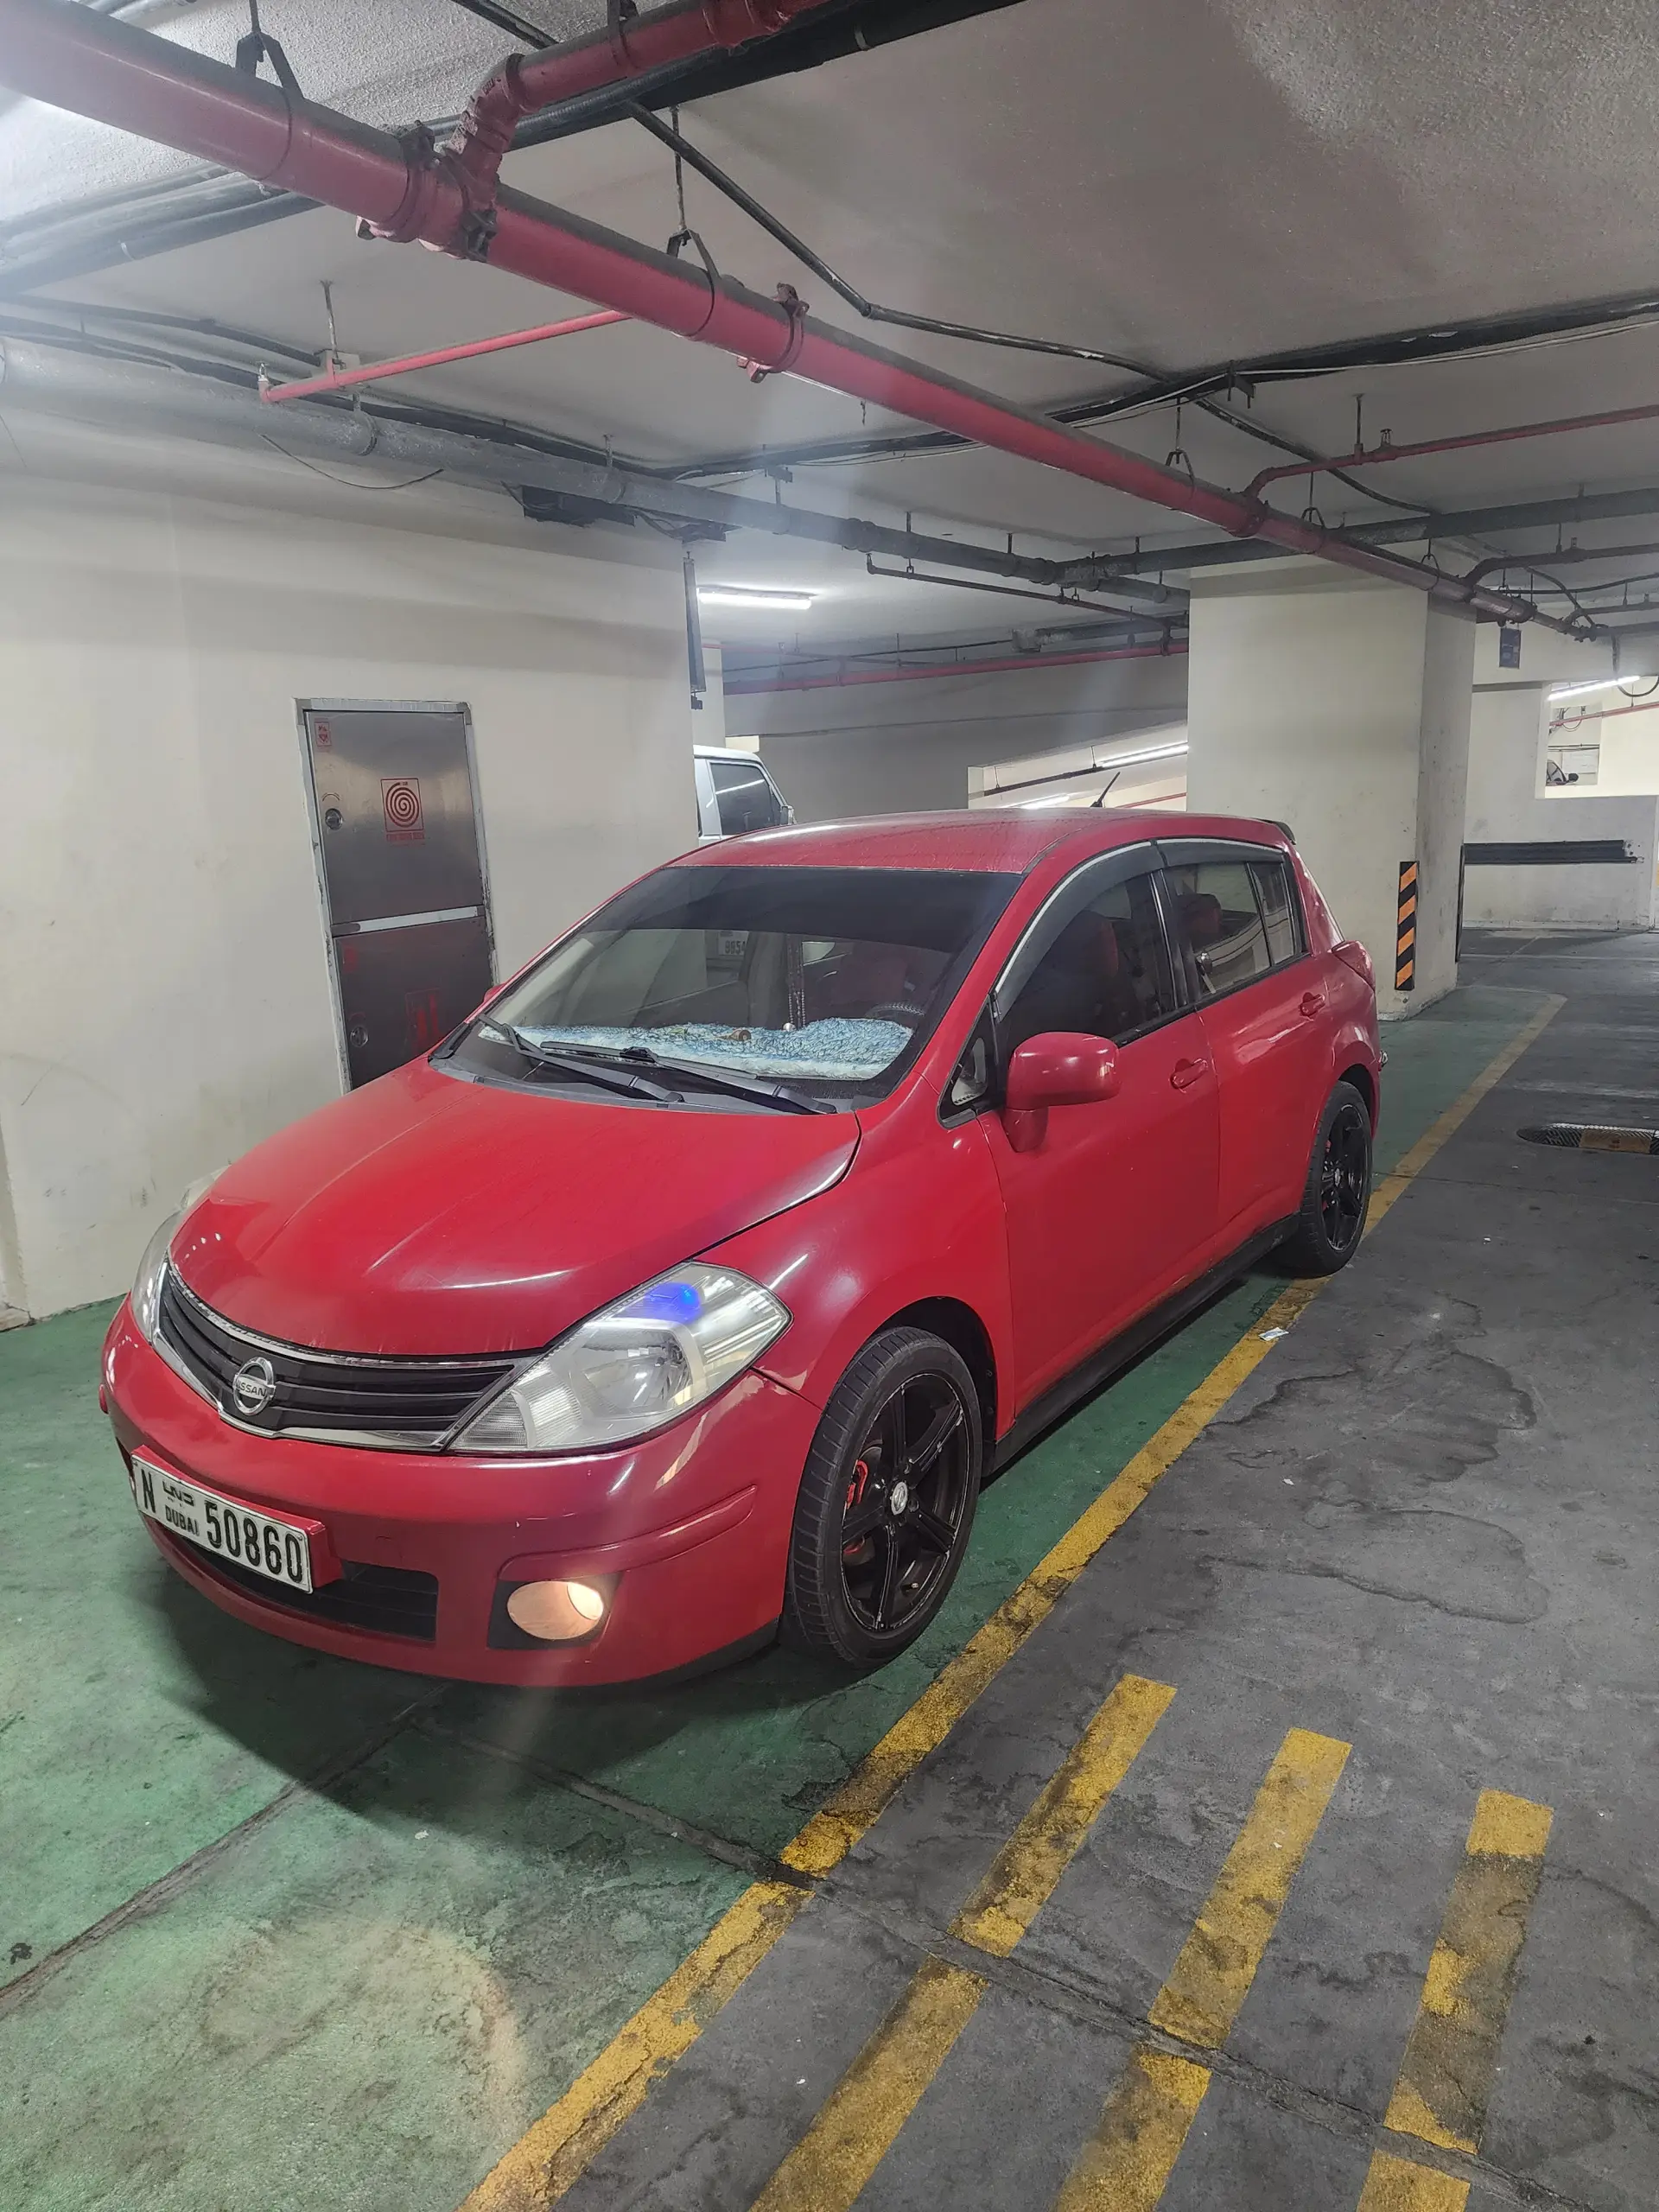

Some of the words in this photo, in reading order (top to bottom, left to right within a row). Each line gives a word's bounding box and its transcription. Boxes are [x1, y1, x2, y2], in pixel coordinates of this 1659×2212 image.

[141, 1469, 156, 1513] N
[165, 1504, 200, 1536] DUBAI
[204, 1502, 302, 1583] 50860
